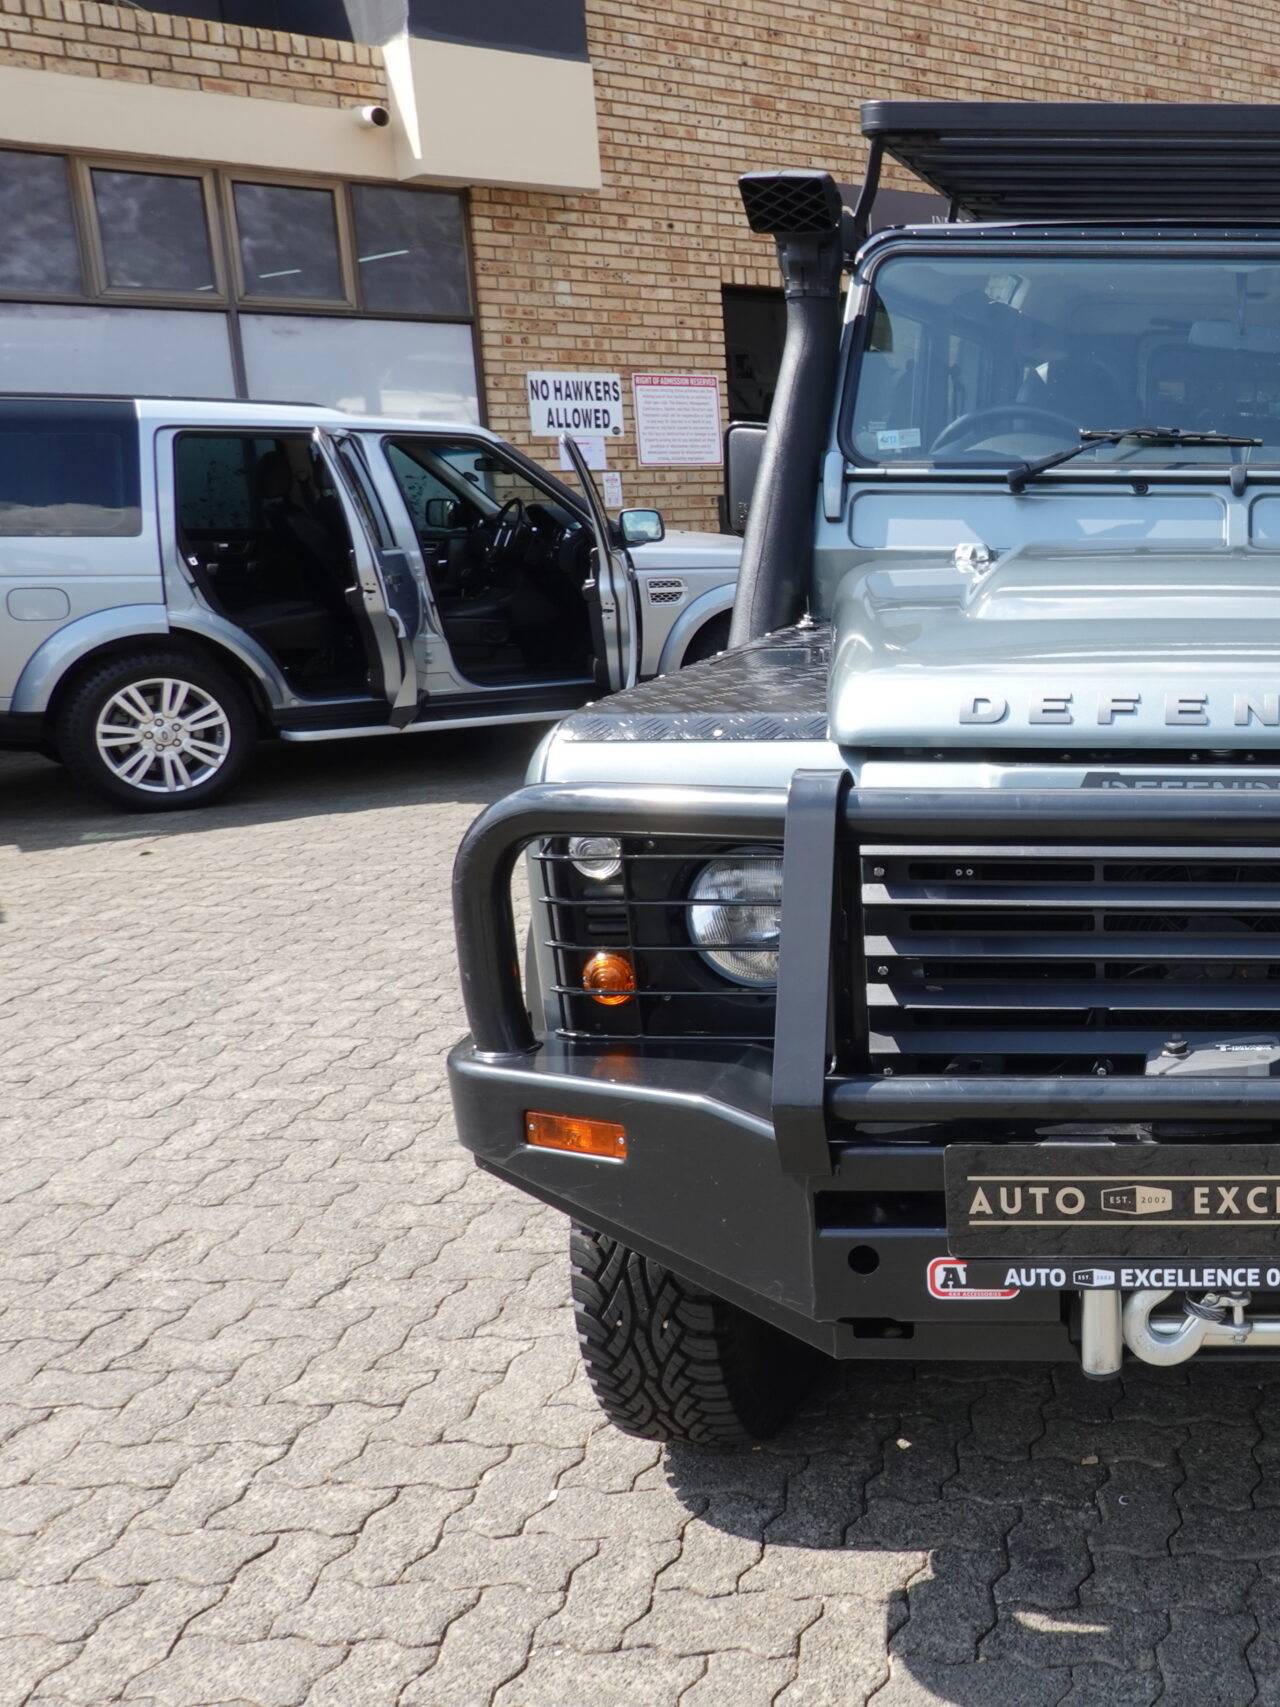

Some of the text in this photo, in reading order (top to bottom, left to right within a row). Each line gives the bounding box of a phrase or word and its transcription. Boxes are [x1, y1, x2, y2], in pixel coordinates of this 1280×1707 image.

[530, 379, 620, 402] NO HAWKERS
[636, 376, 652, 384] RIGHT
[660, 377, 689, 385] ADMISSION
[690, 378, 716, 386] RESERVED
[547, 407, 611, 429] ALLOWED
[968, 1186, 1086, 1215] AUTO
[1109, 1196, 1132, 1204] EST.
[1141, 1196, 1167, 1204] 2002
[1004, 1268, 1066, 1287] AUTO
[1120, 1268, 1260, 1287] EXCELLENCE
